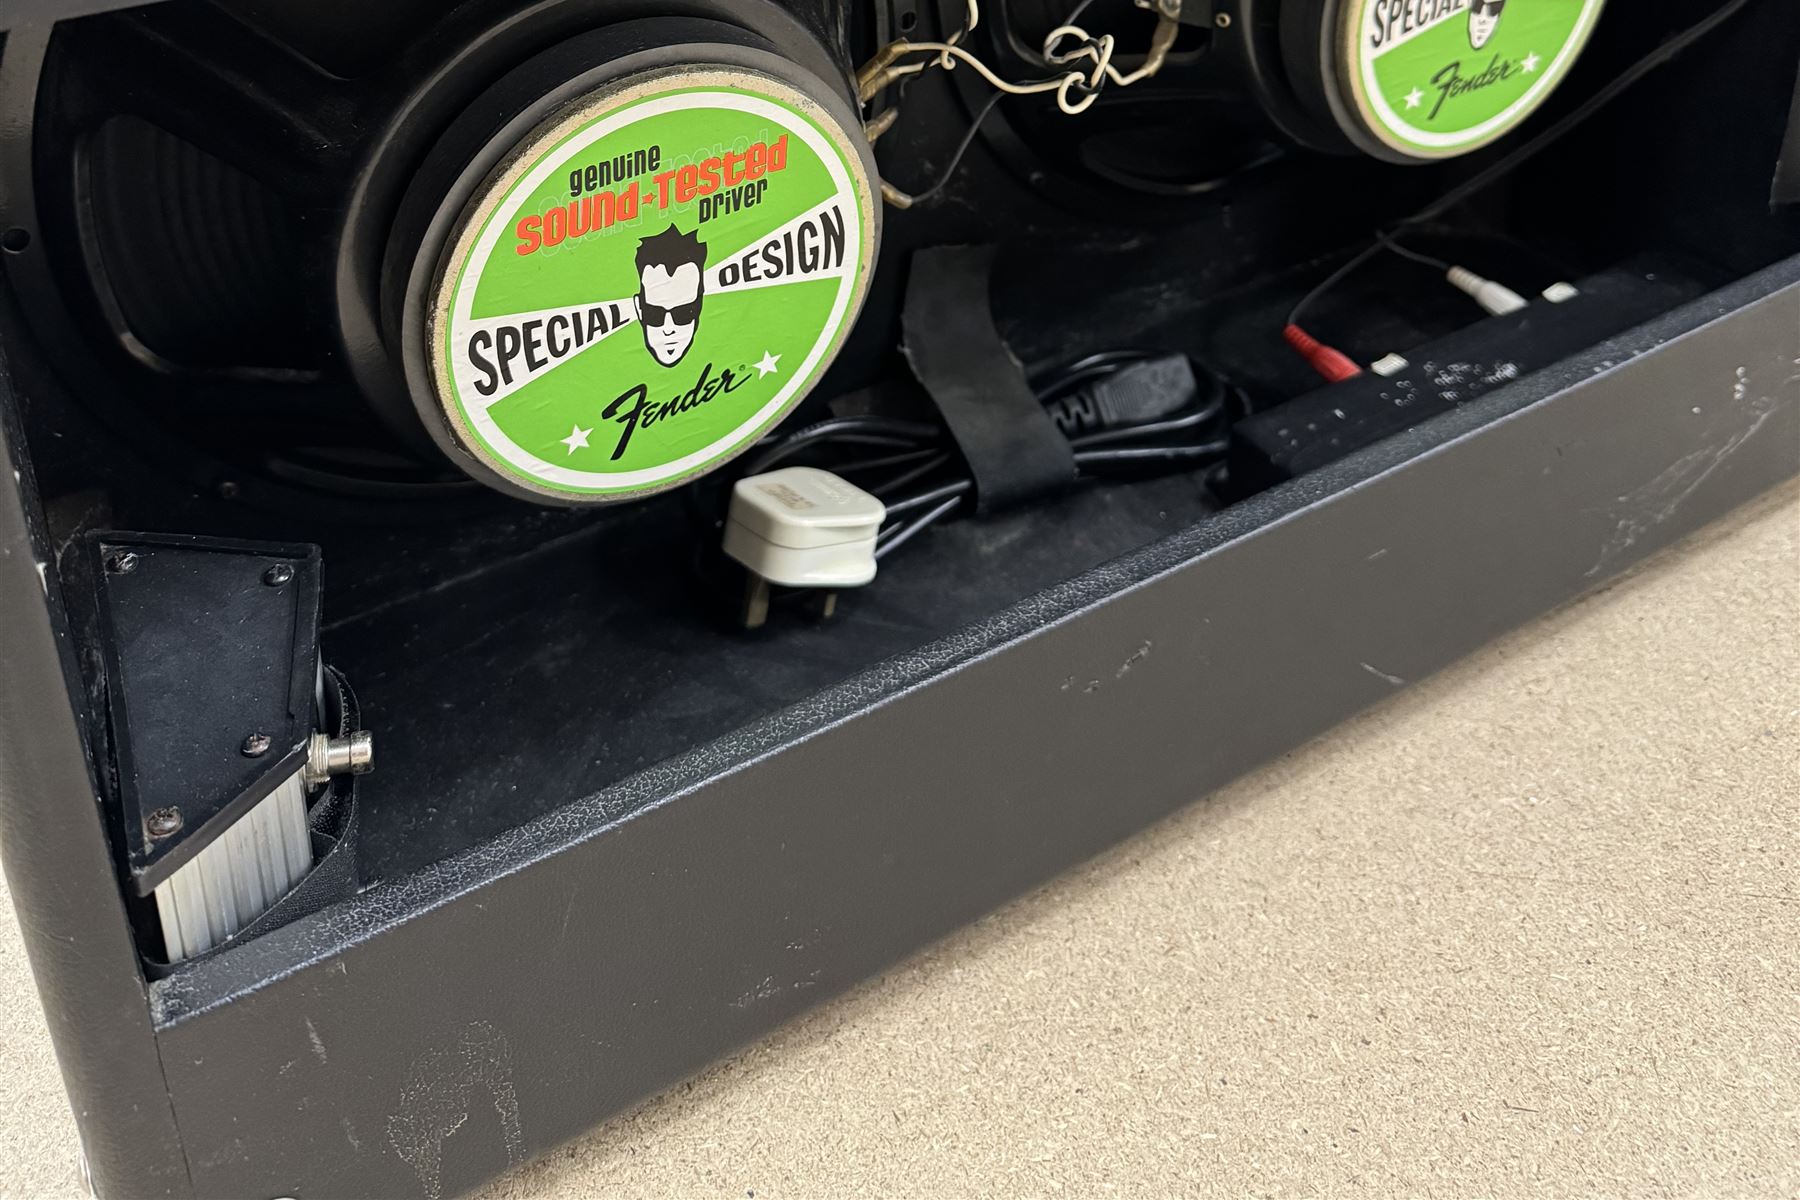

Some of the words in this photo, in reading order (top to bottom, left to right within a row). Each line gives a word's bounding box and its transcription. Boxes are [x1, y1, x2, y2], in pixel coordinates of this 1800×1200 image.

[1427, 53, 1522, 121] Fender
[570, 145, 660, 197] genuine
[468, 303, 630, 396] SPECIAL
[718, 205, 845, 288] DESIGN
